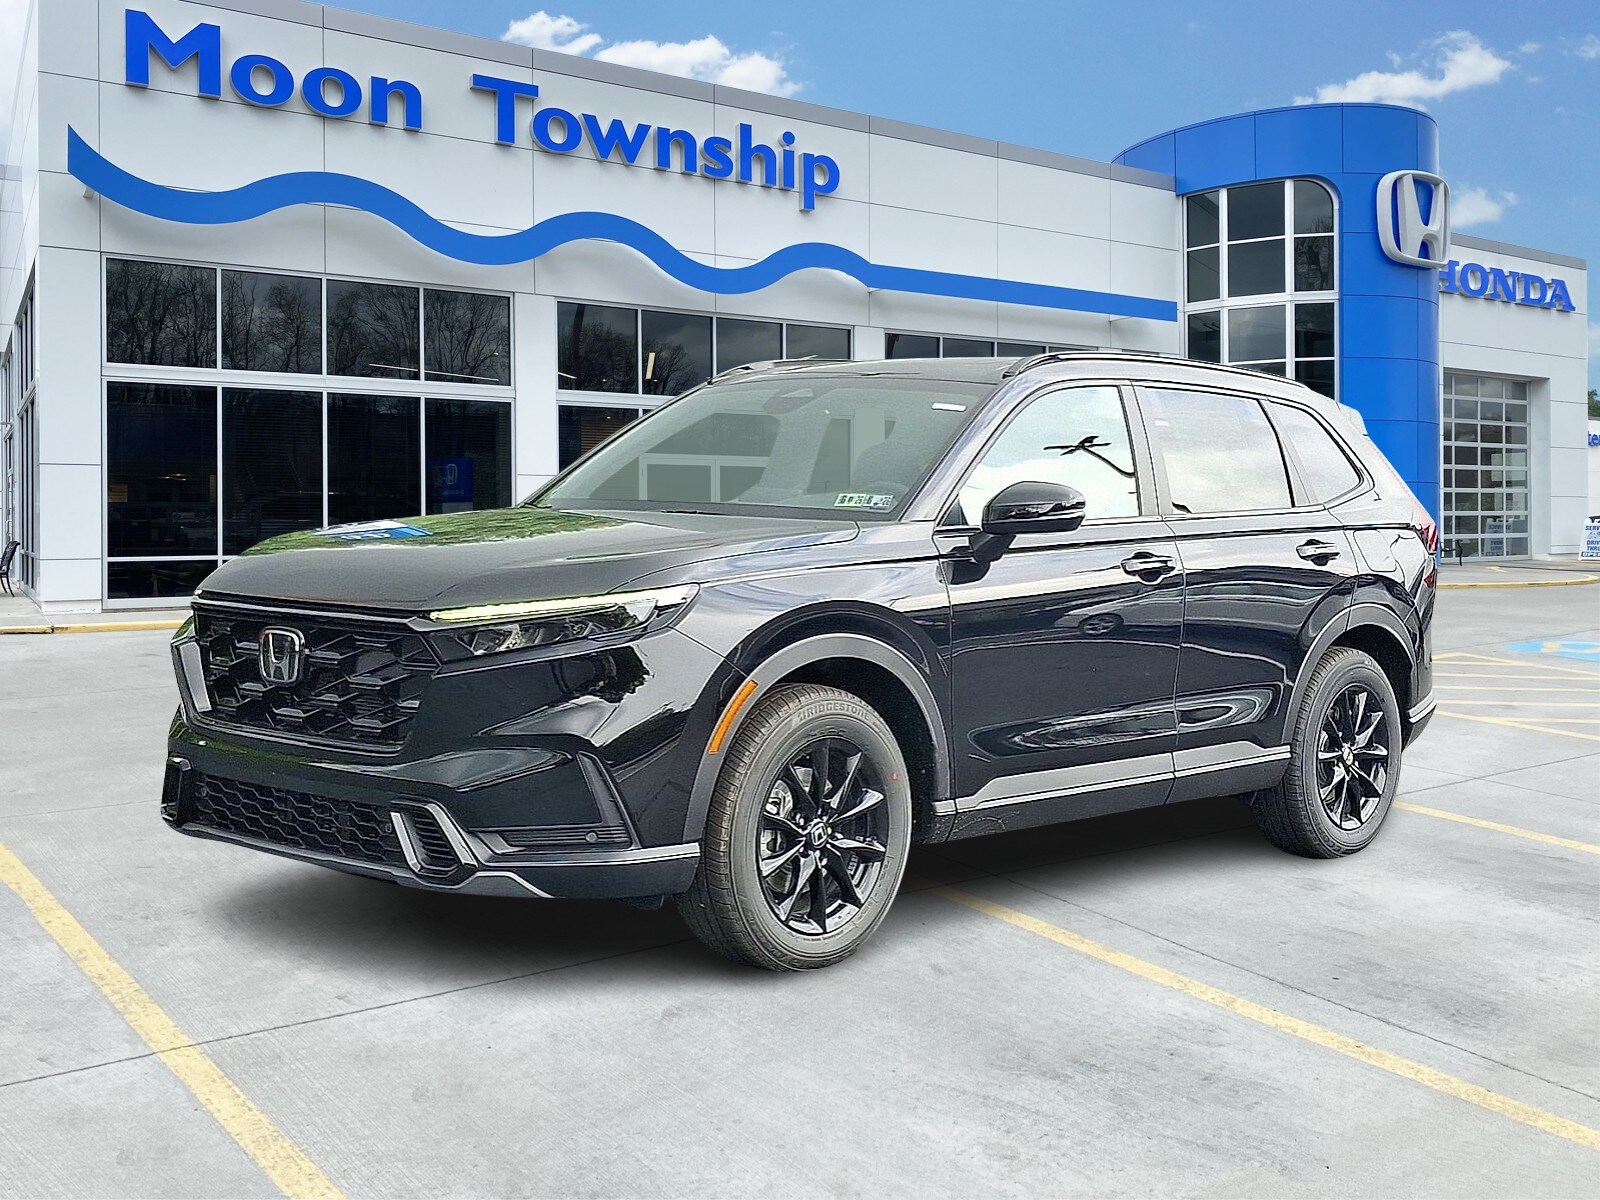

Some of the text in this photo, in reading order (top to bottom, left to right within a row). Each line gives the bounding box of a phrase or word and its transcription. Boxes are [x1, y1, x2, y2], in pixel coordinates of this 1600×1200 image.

[125, 9, 841, 212] Moon Township
[797, 701, 870, 722] BRIDGESTONE
